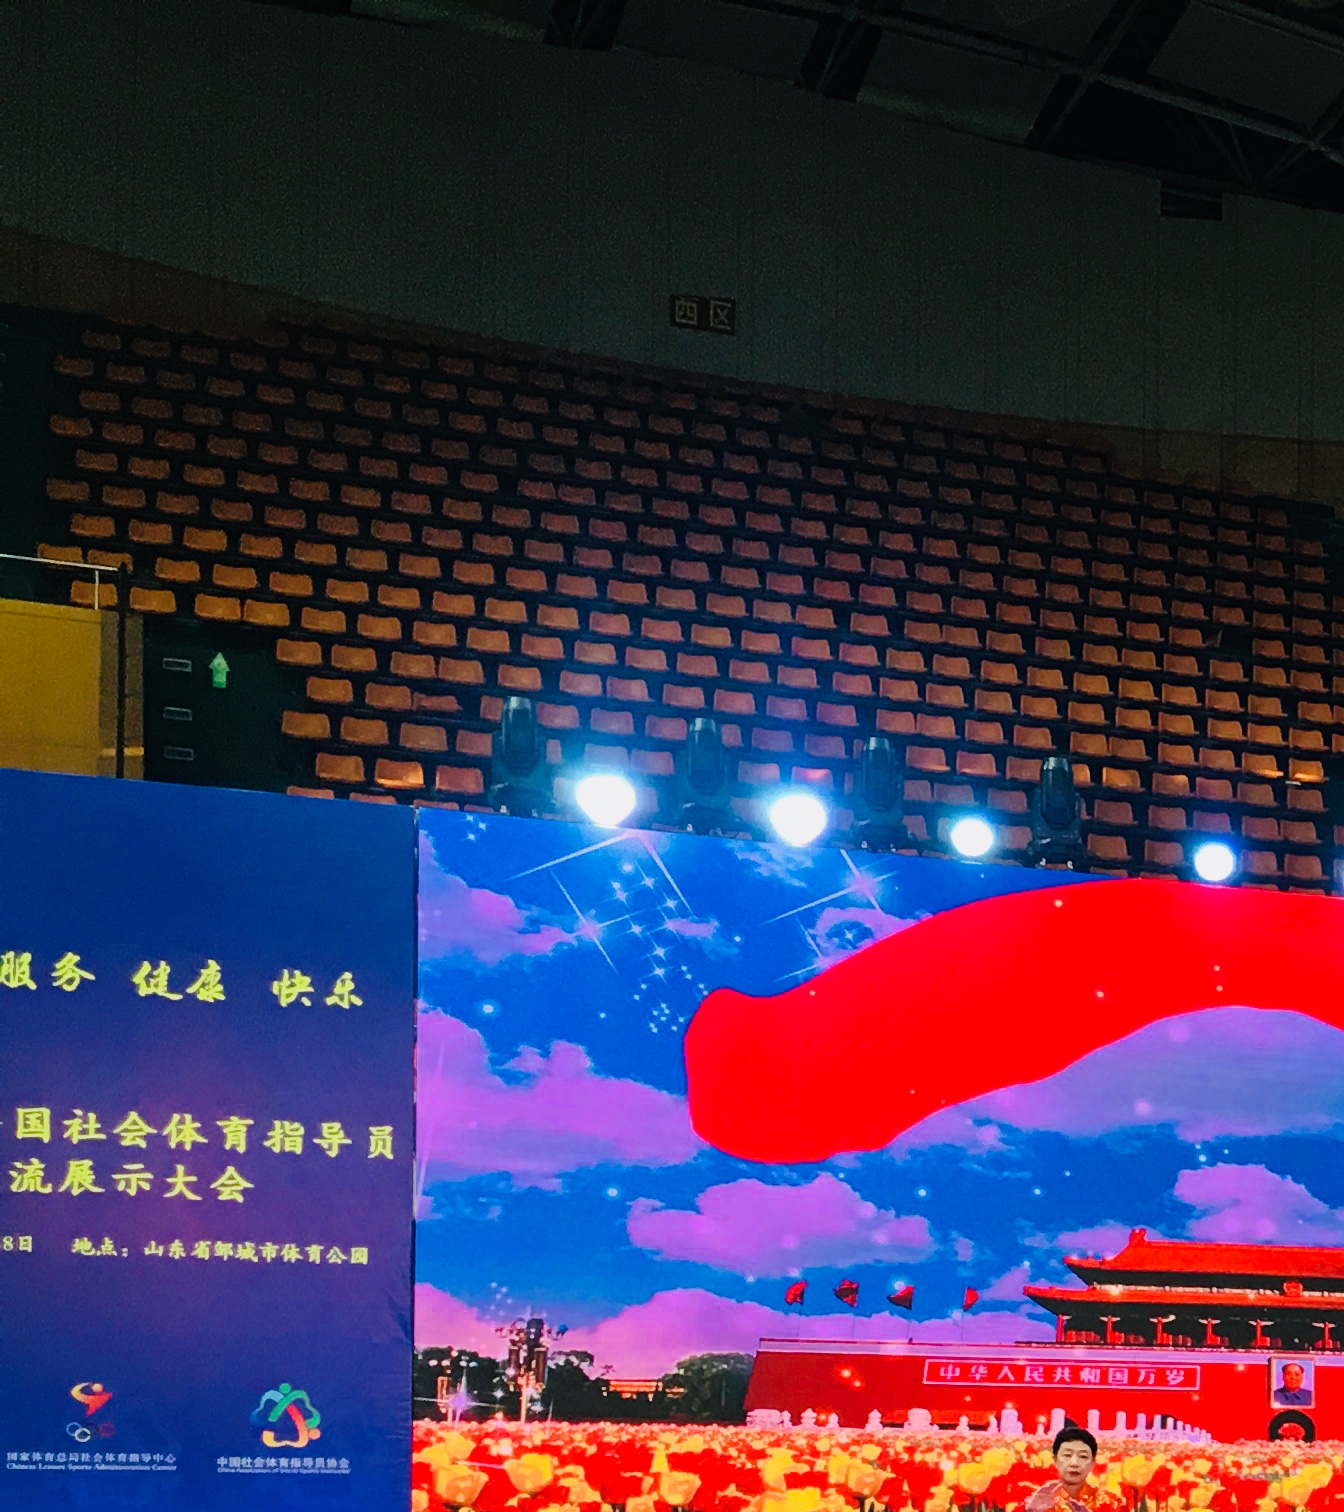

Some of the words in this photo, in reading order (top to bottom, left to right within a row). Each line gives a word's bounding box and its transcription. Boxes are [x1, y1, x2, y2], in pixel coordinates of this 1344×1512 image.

[0, 951, 95, 992] 服务
[132, 959, 226, 1002] 健康
[272, 969, 363, 1010] 快乐
[0, 1106, 394, 1160] 国社会体育指导员
[9, 1158, 255, 1203] 流展示大会
[939, 1363, 1186, 1386] 中华人民共和国万岁
